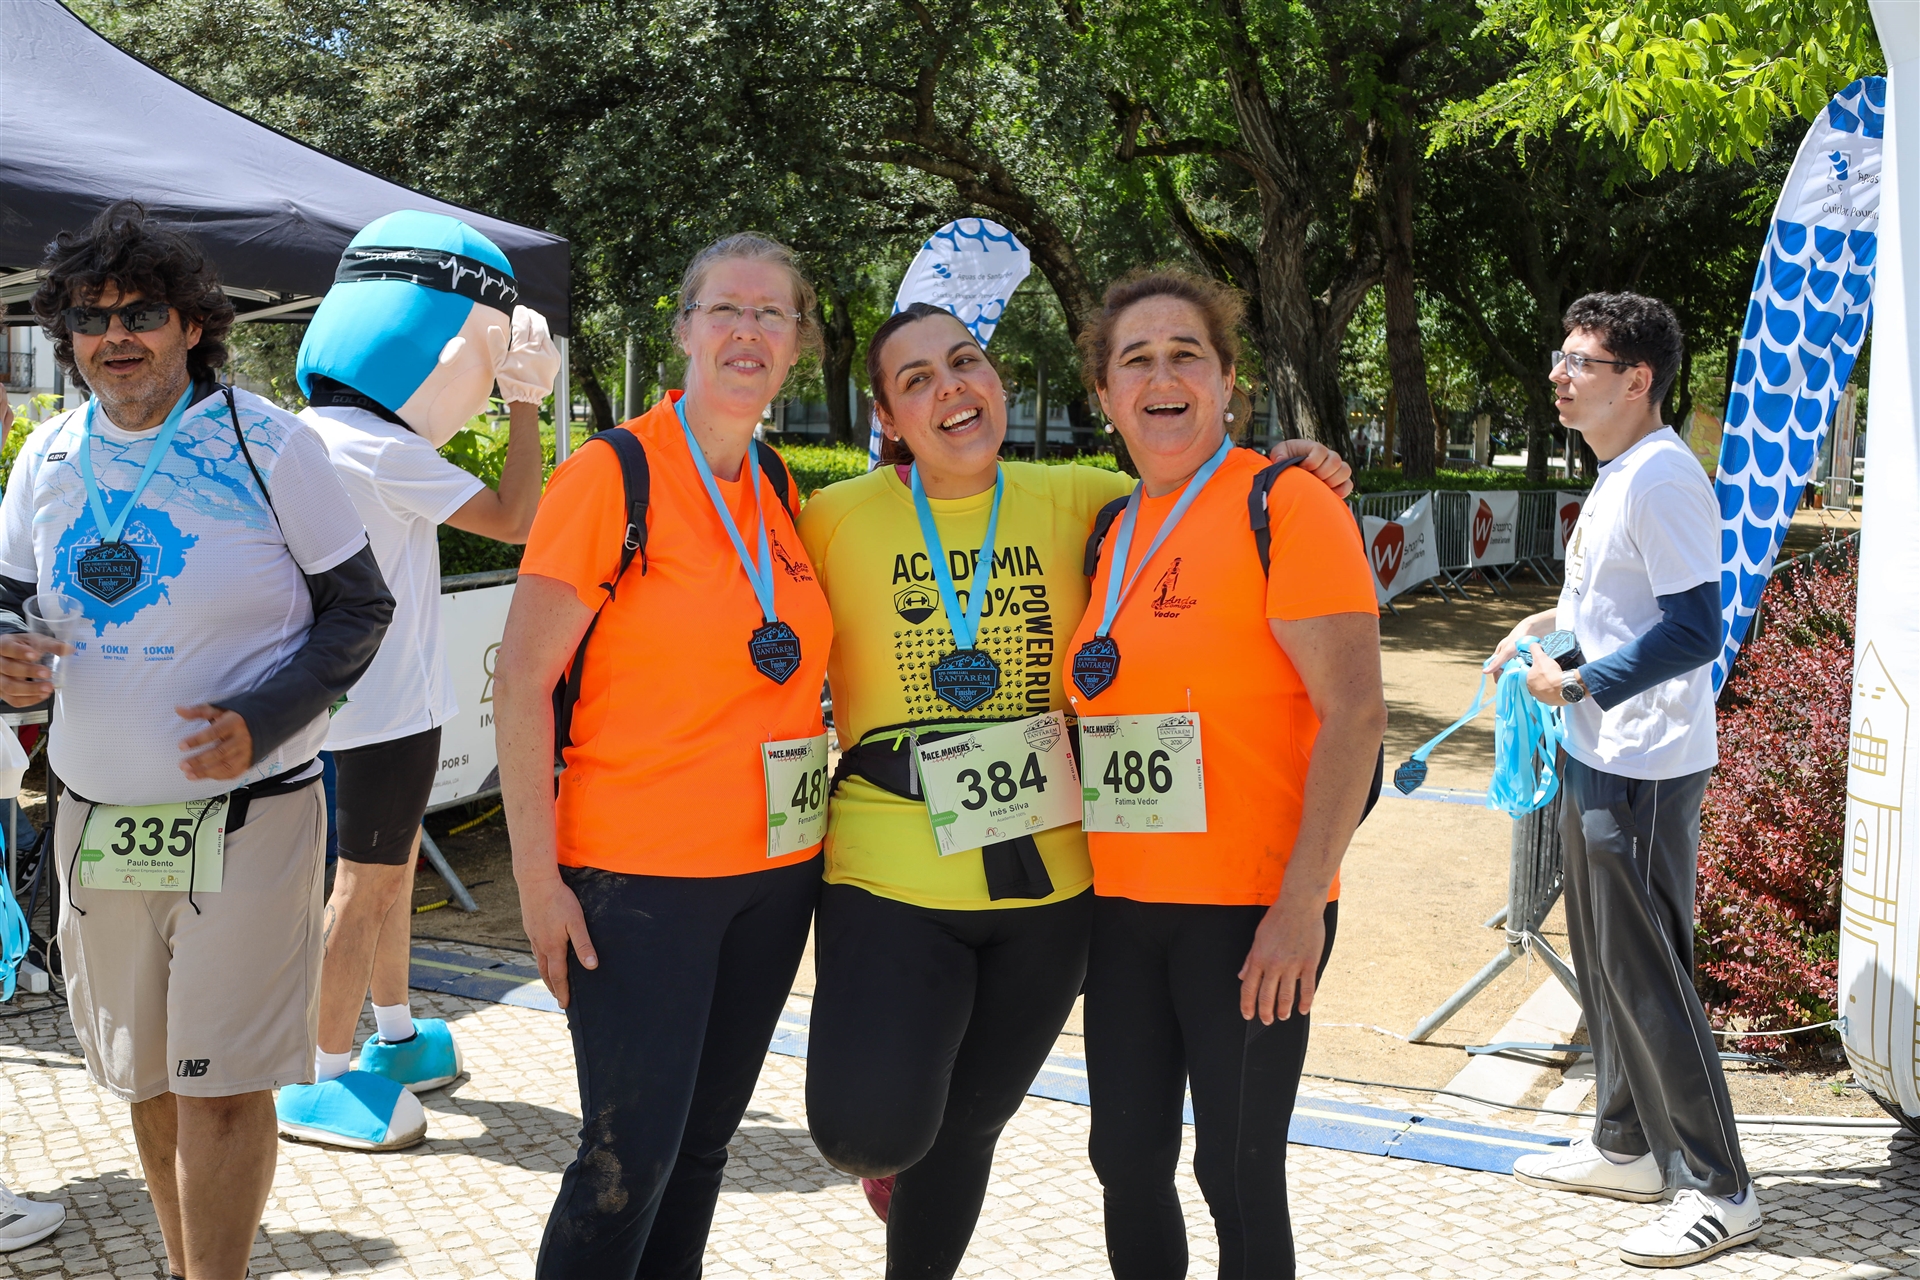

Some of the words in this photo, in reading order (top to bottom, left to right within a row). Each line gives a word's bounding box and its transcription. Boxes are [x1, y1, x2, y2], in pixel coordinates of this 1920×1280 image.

[1476, 517, 1492, 541] W
[1374, 541, 1402, 572] W
[84, 563, 131, 574] SANTARÉM
[892, 545, 1044, 585] ACDMIA
[1163, 595, 1197, 605] Anda
[101, 644, 129, 654] 10KM
[143, 646, 175, 655] 10KM
[756, 644, 795, 655] SANTARÉM
[1076, 660, 1112, 668] SANTARÉM
[938, 673, 991, 682] SANTARÉM
[955, 687, 978, 696] Finisher
[1027, 727, 1058, 740] SANTARÉM
[441, 756, 460, 771] POR
[461, 754, 469, 765] SI
[1103, 750, 1173, 794] 486
[956, 751, 1047, 810] 384
[791, 764, 828, 813] 487
[1137, 797, 1159, 805] Vedor
[989, 807, 1008, 817] Inês
[1008, 802, 1029, 812] Silva
[111, 816, 193, 857] 335
[127, 859, 149, 867] Paulo
[151, 859, 174, 867] Bento
